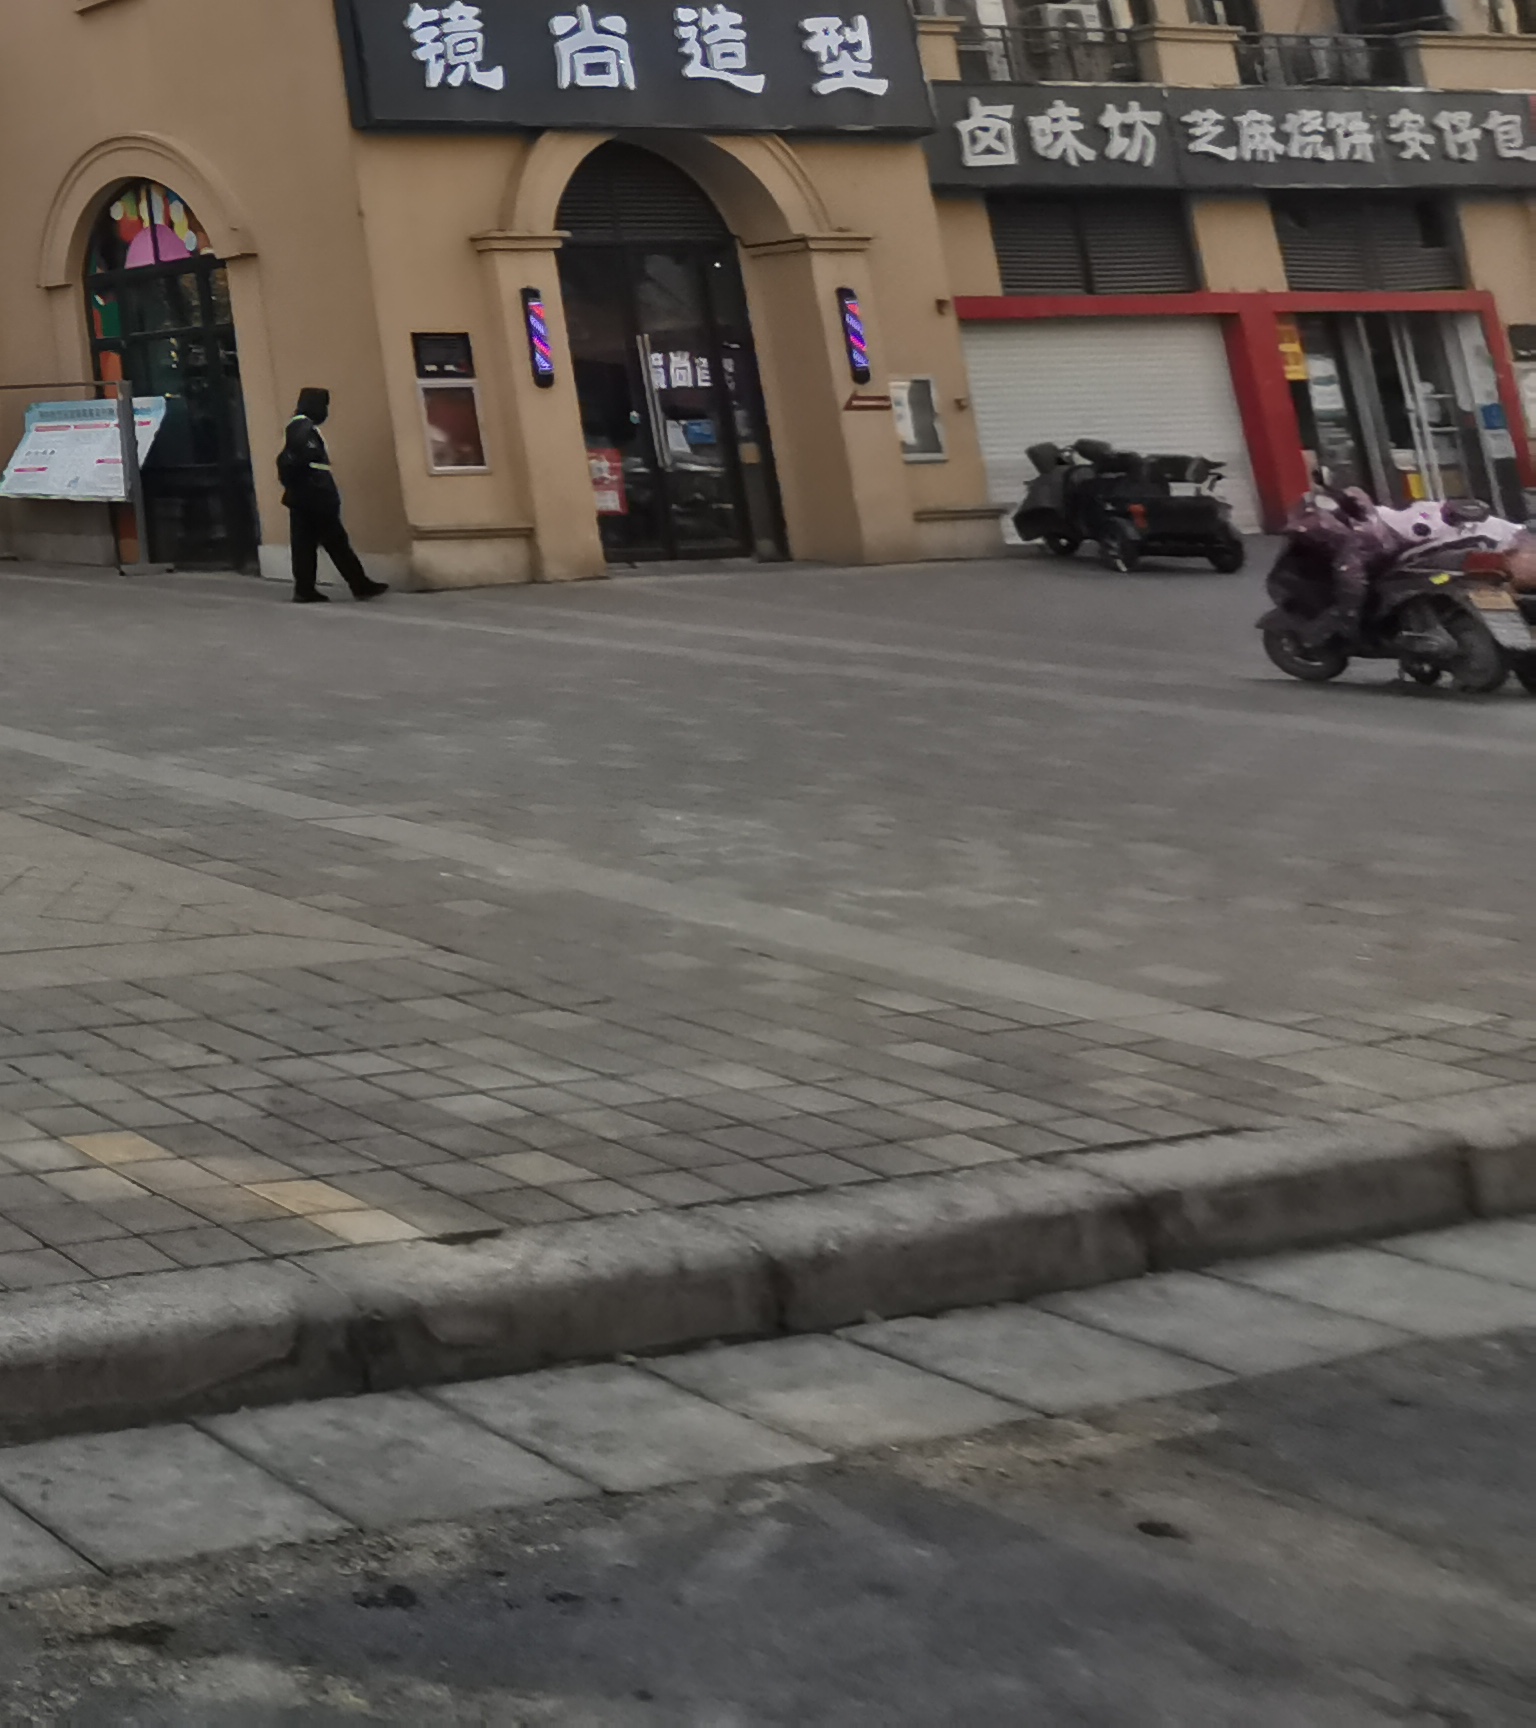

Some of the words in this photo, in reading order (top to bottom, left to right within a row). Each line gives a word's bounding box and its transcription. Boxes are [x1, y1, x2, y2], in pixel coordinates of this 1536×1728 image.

[405, 2, 889, 96] 镜尚造型
[955, 97, 1162, 168] 卤味坊
